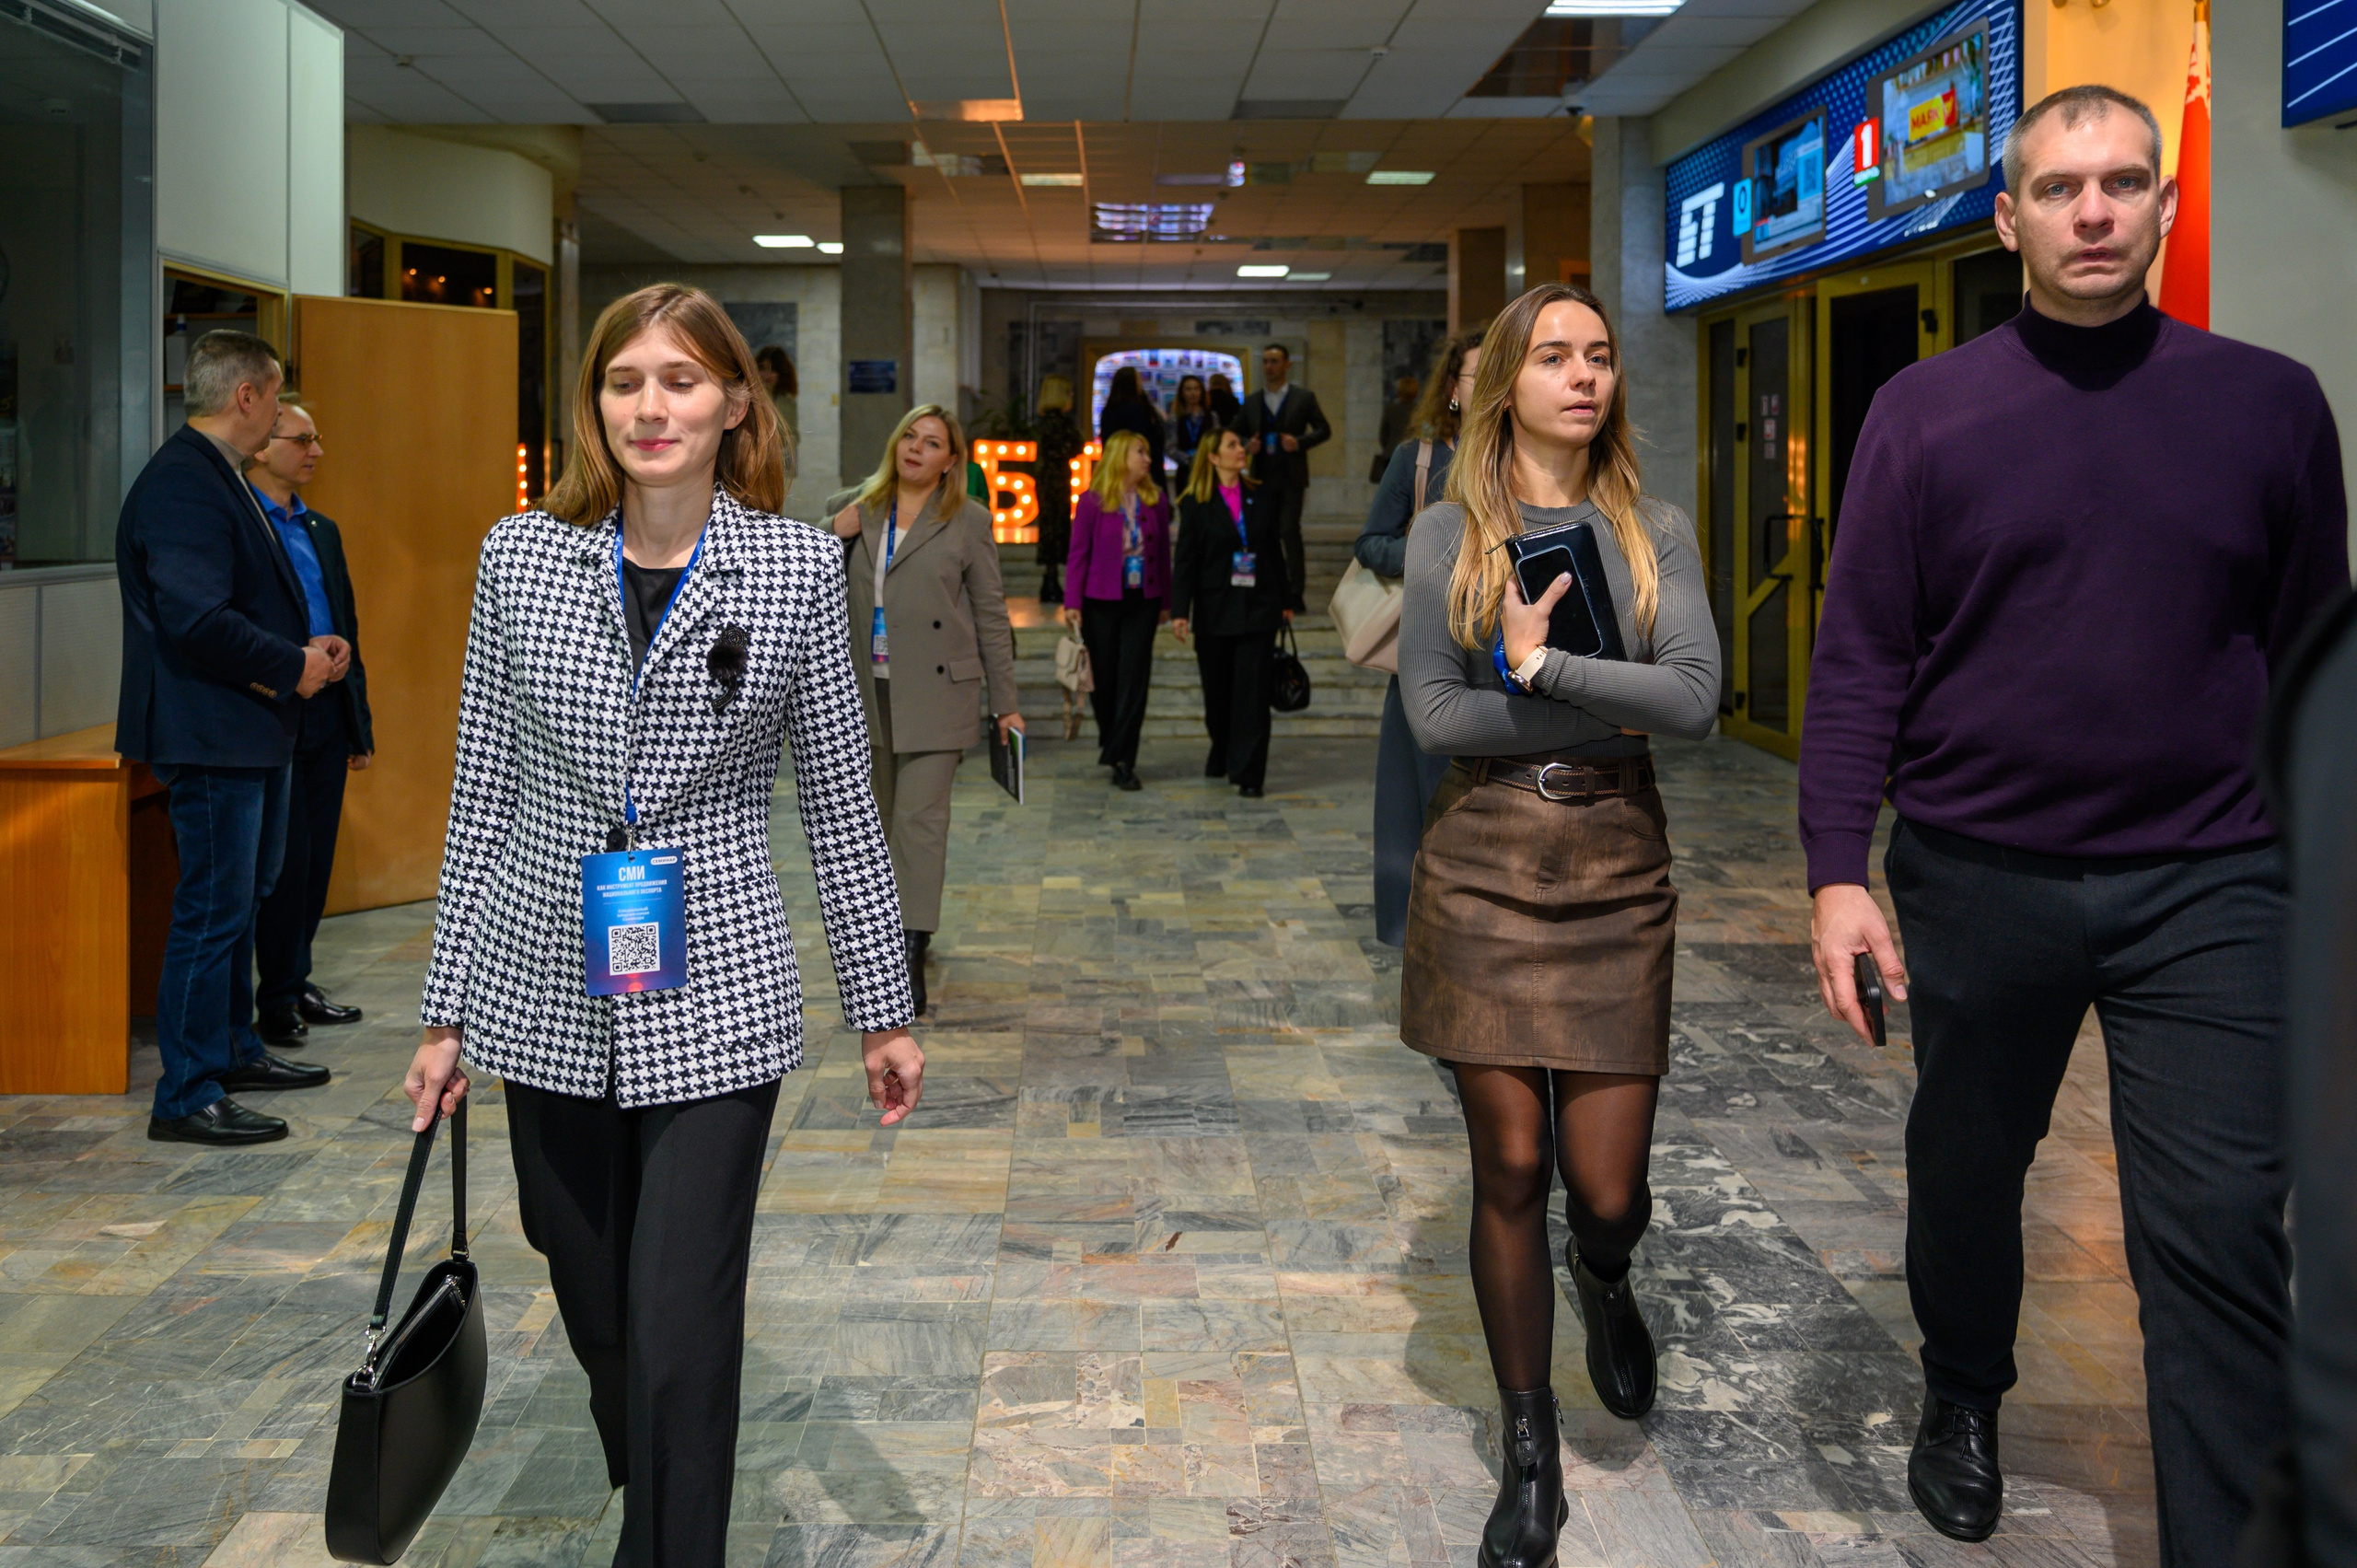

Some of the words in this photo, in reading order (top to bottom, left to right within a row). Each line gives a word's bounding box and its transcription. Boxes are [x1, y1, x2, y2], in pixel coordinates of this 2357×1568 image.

[1861, 123, 1873, 168] 1
[619, 865, 645, 881] СМИ
[607, 882, 634, 890] ИНСТРУМЕНТ
[635, 879, 668, 888] ПРОДВИЖЕНИЯ
[602, 889, 640, 898] НАЦИОНАЛЬНОГО
[640, 887, 662, 895] ЭКСПОРТА
